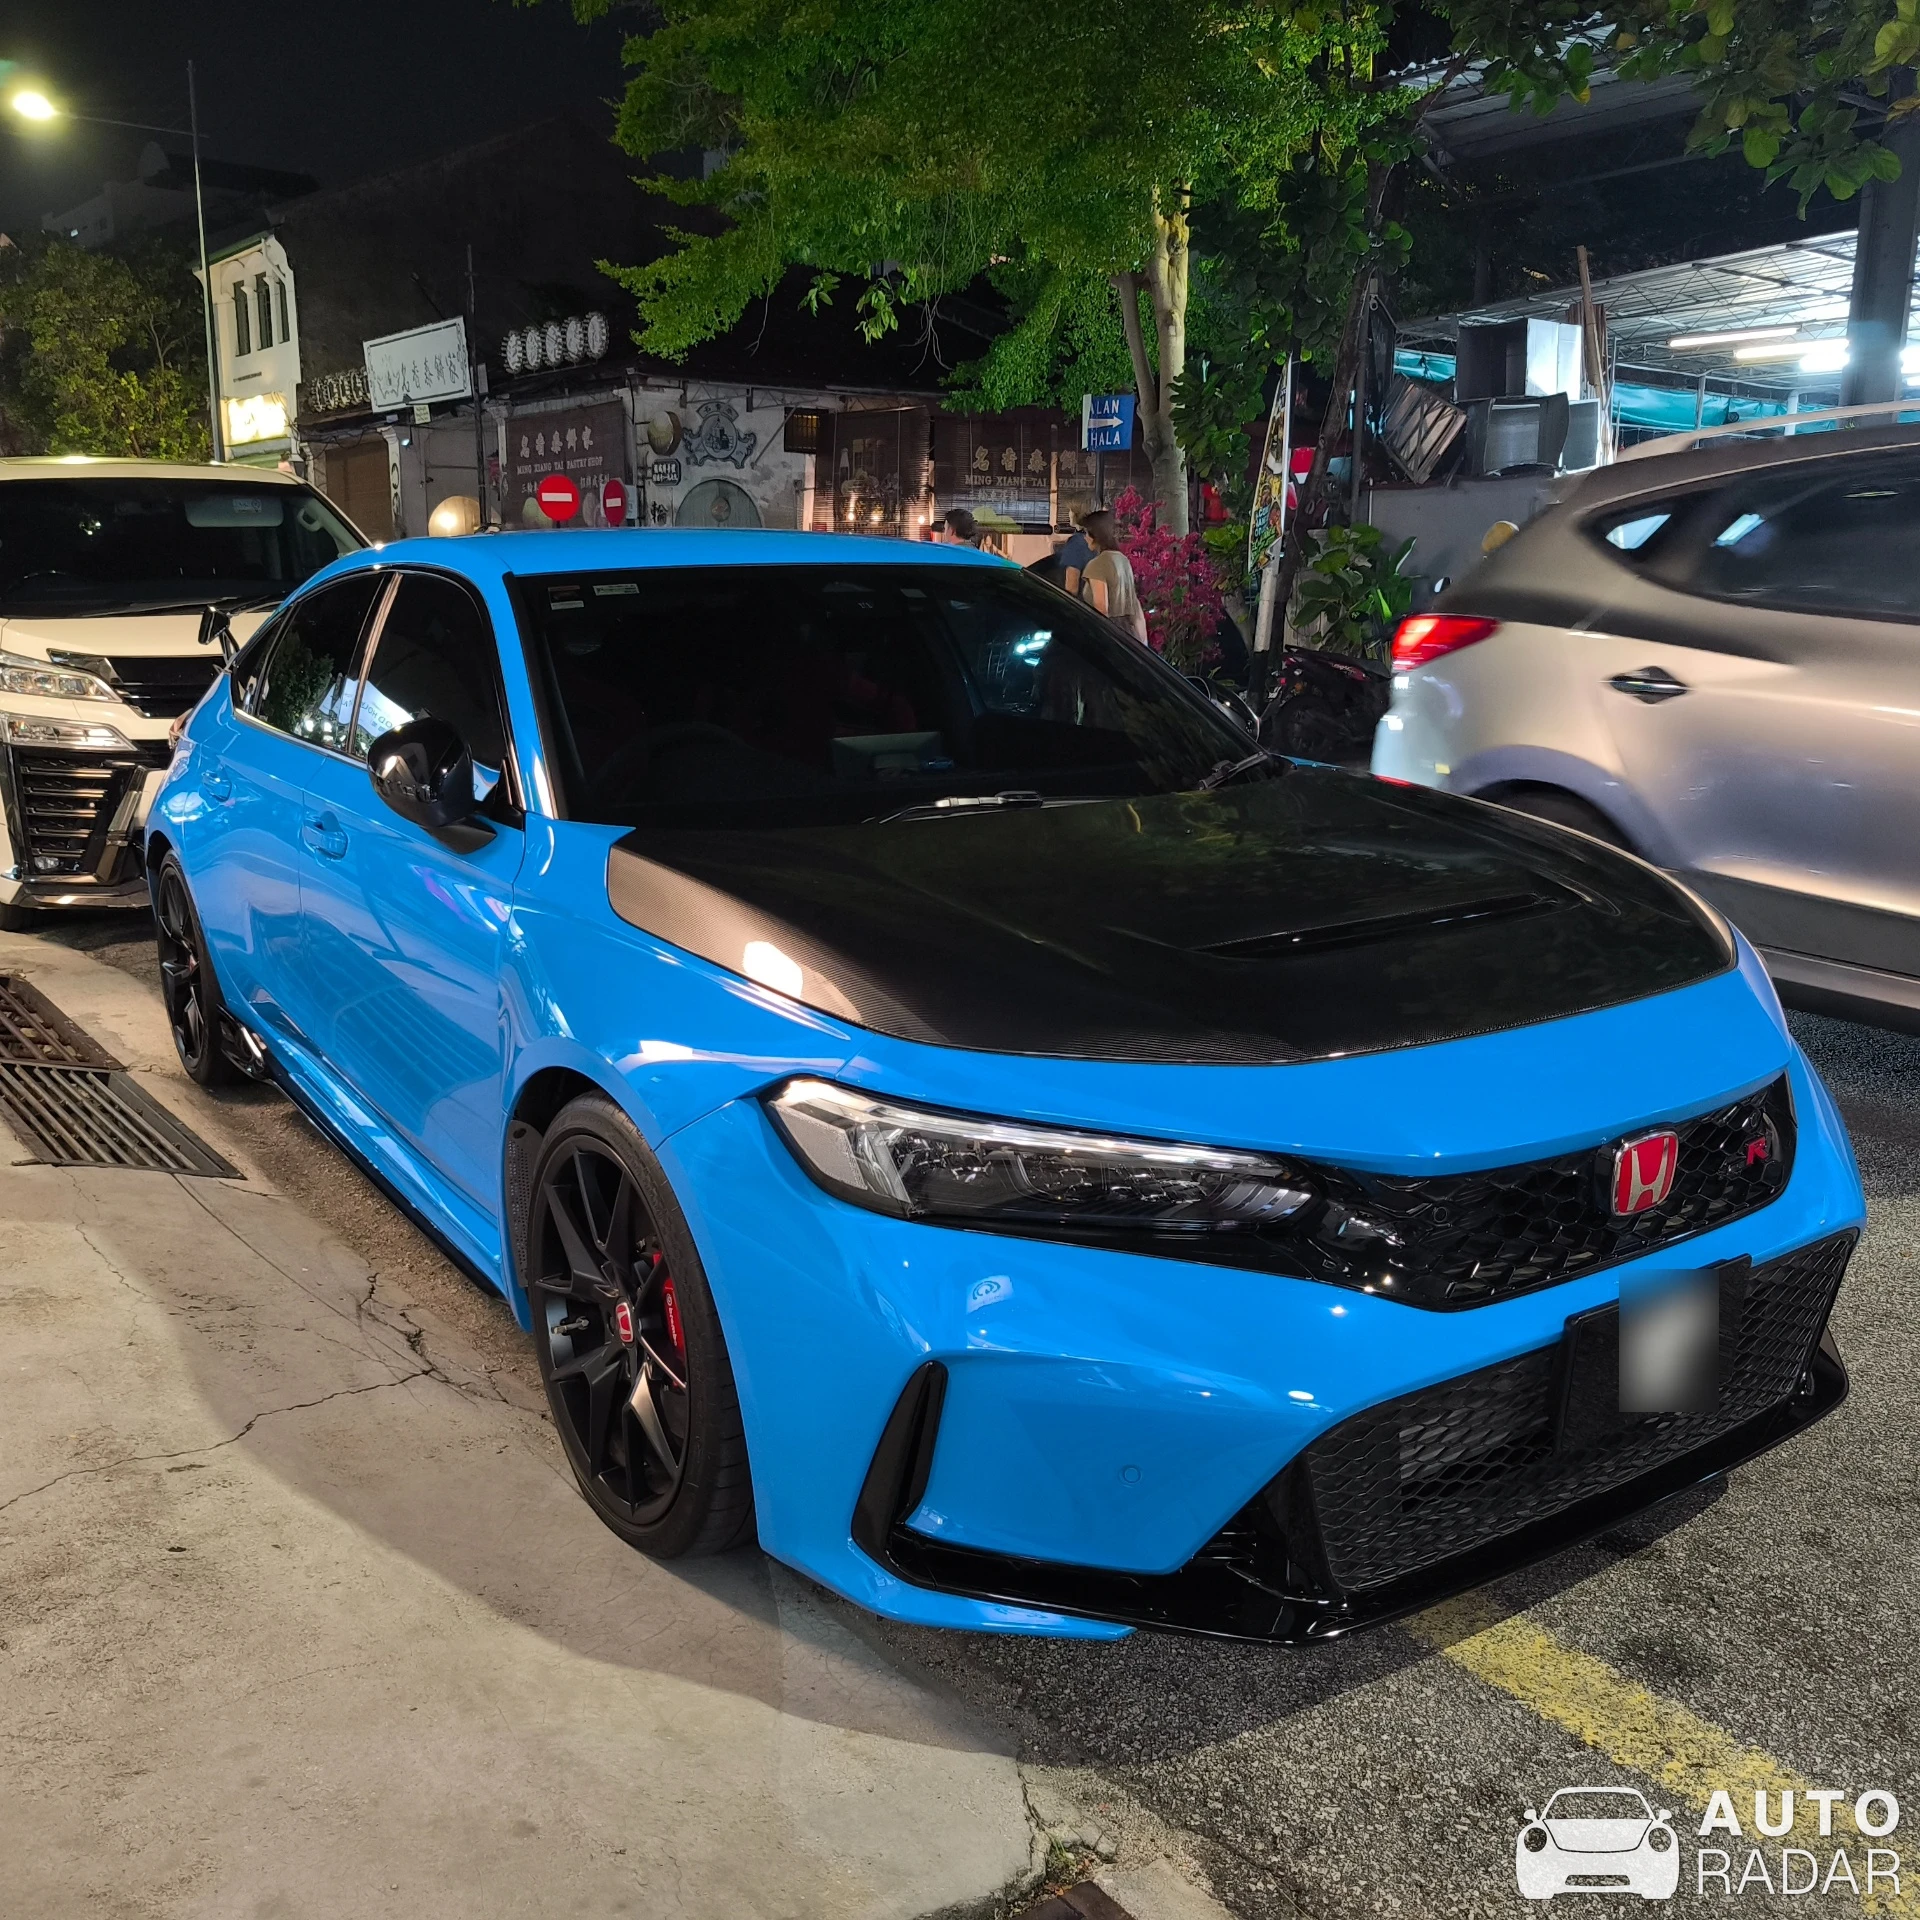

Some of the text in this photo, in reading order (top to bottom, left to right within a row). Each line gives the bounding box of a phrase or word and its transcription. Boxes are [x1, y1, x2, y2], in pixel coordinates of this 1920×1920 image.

[1090, 430, 1121, 447] HALA
[517, 464, 532, 476] MING
[534, 462, 552, 473] XIANG
[554, 460, 564, 471] TAI
[567, 457, 588, 470] PASTRY
[964, 474, 993, 486] MING
[996, 475, 1027, 487] XIANG
[1032, 477, 1048, 488] TAI
[1058, 478, 1092, 489] PASTRY
[668, 1307, 678, 1347] brembo
